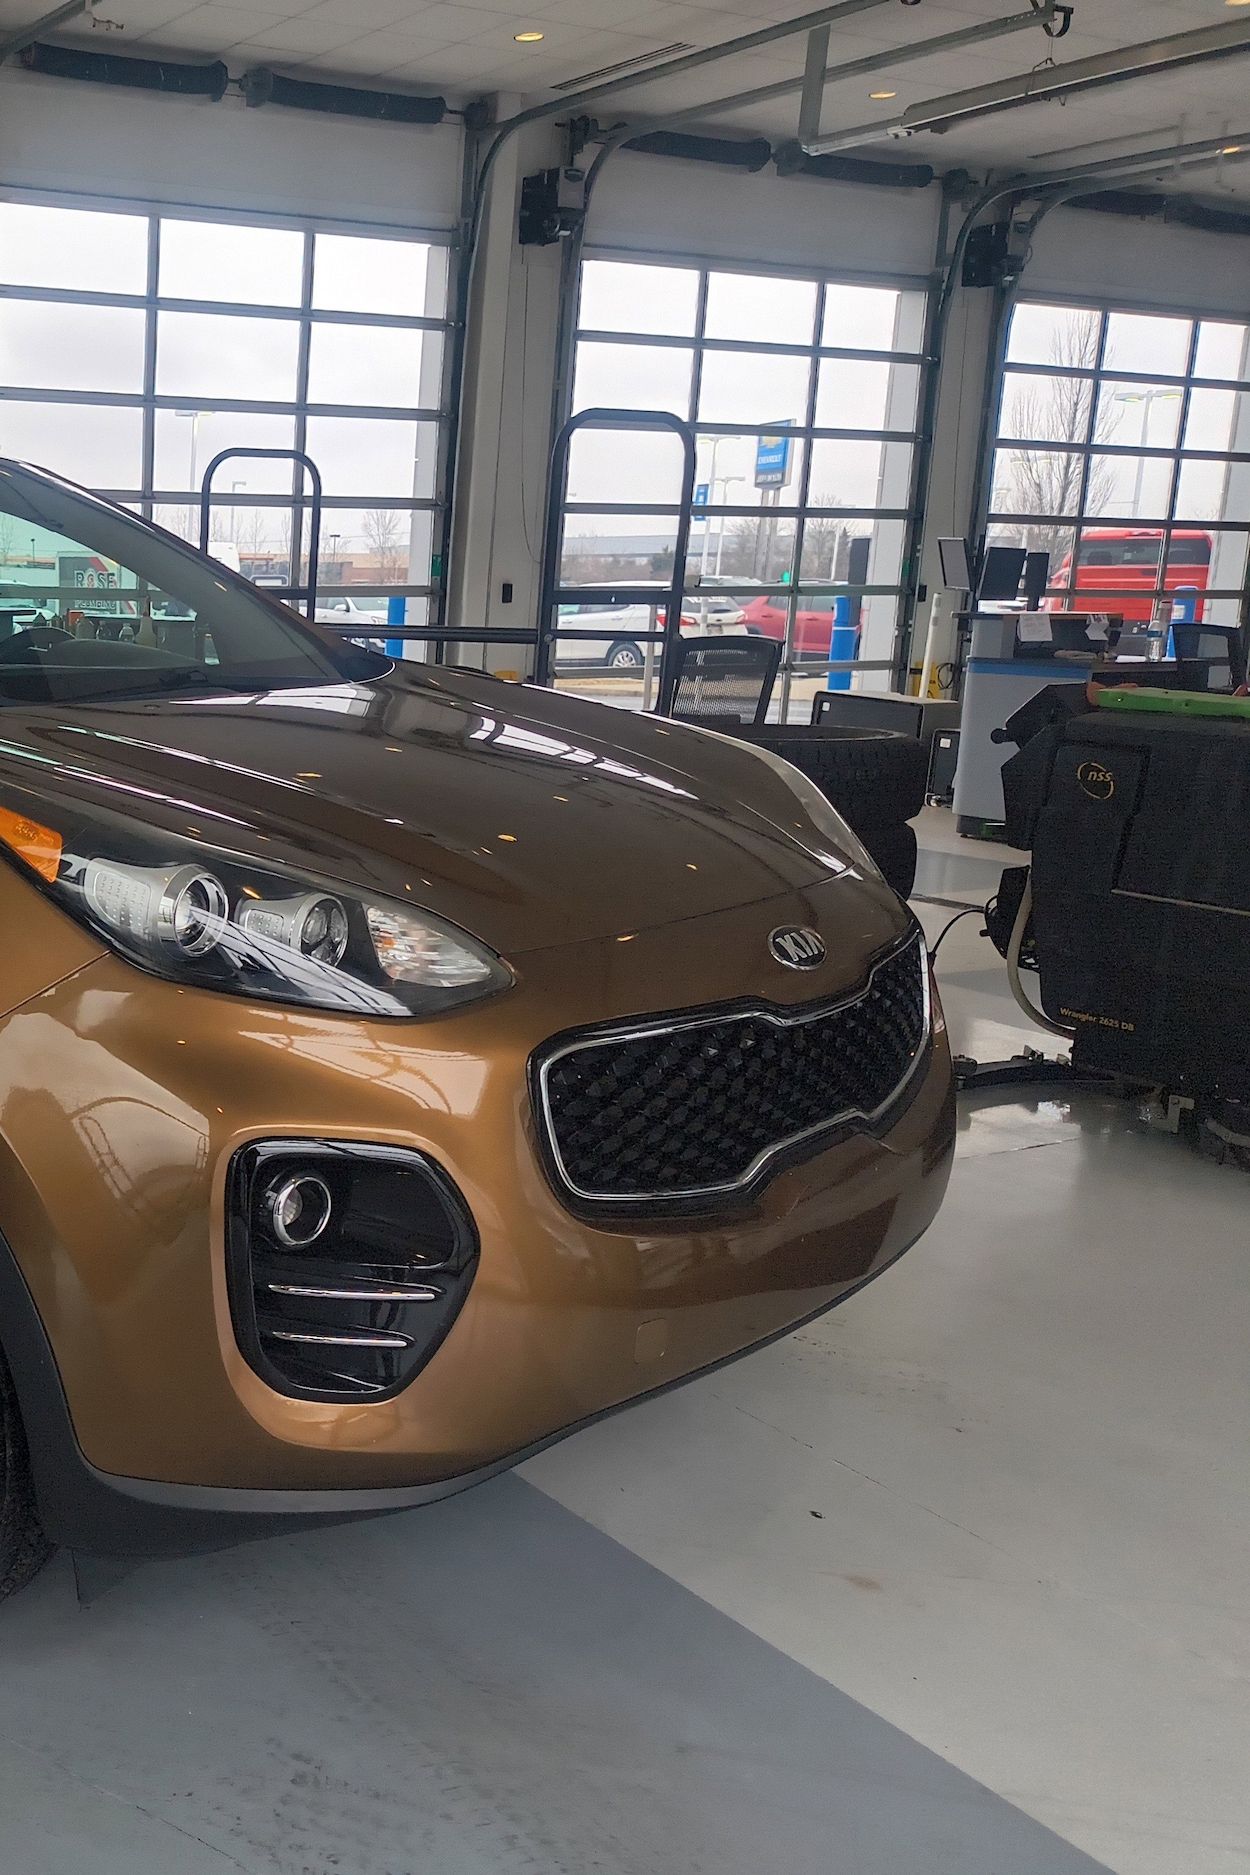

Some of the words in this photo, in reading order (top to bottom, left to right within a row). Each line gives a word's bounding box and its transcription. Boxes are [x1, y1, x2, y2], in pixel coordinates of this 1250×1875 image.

[75, 568, 117, 588] ROSE
[1087, 771, 1113, 782] nss
[775, 930, 825, 962] KIA
[1060, 1007, 1097, 1022] Wrangler
